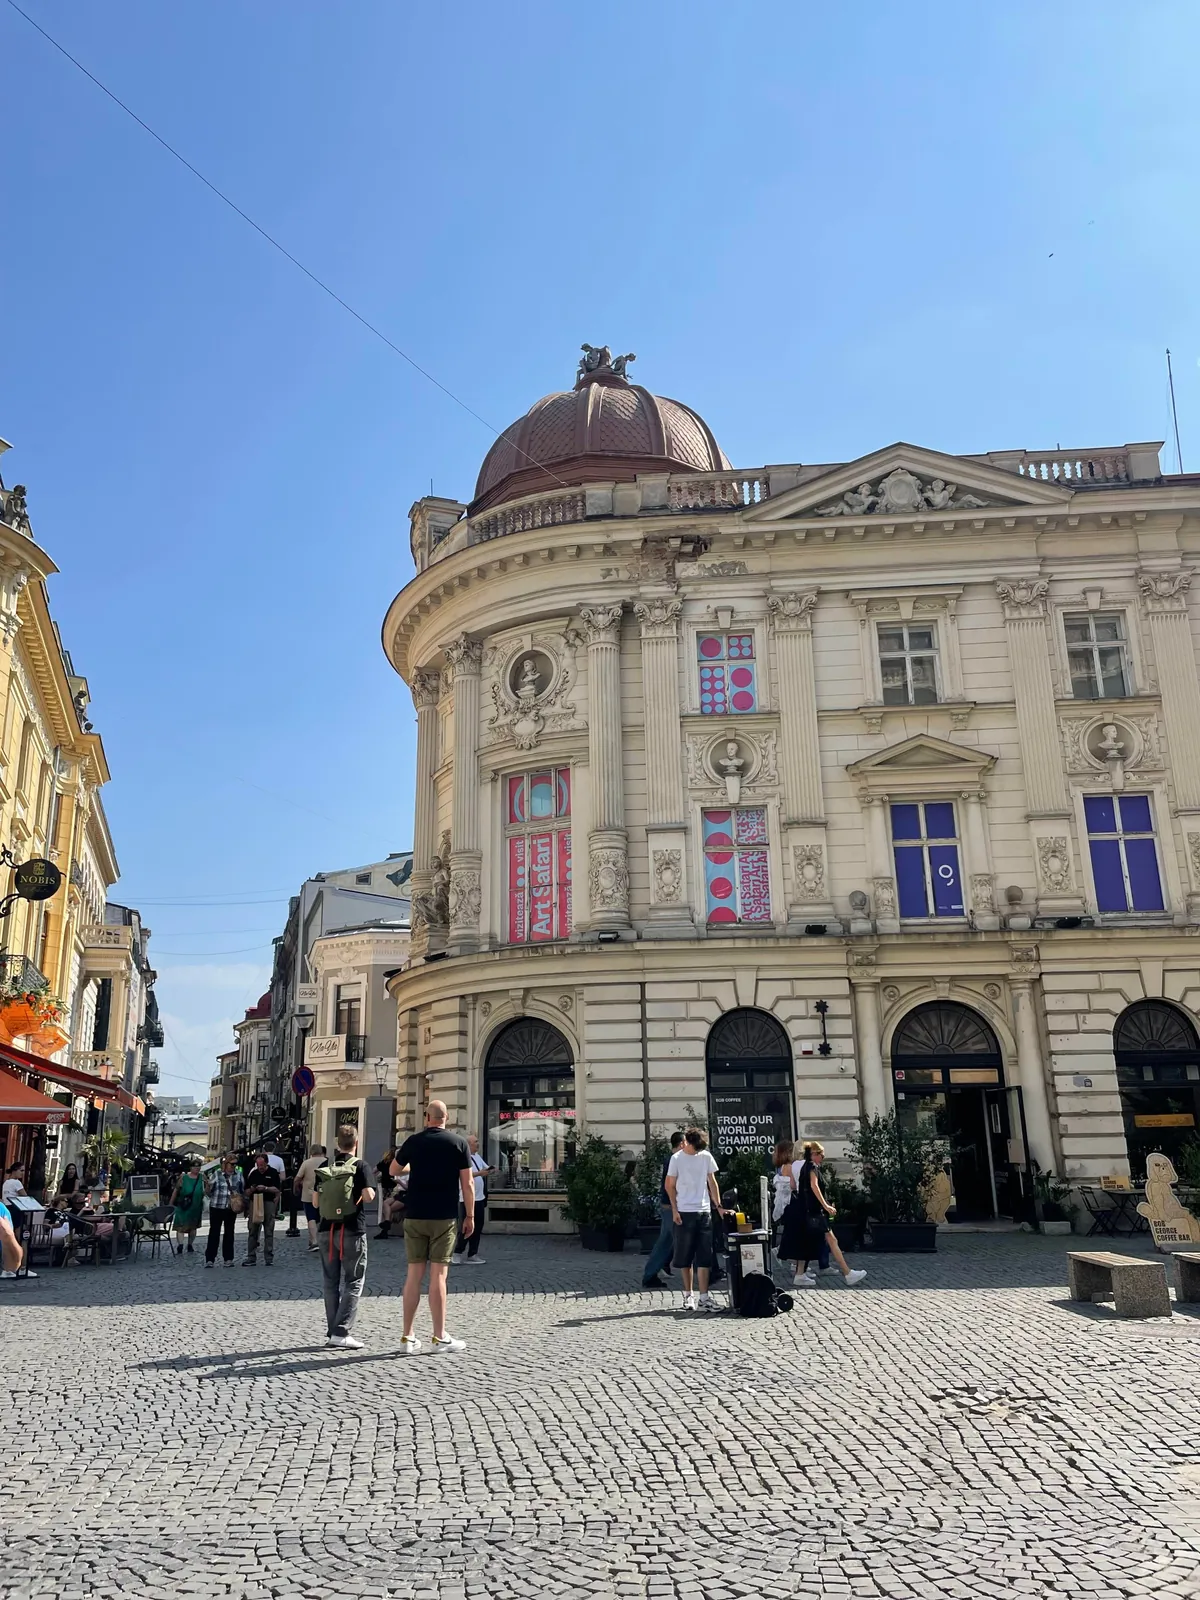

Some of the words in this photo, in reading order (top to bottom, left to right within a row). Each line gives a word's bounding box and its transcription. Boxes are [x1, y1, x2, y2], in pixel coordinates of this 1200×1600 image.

[563, 833, 572, 855] visit
[514, 840, 524, 862] visit
[532, 838, 550, 897] Safari
[20, 875, 56, 885] NOBIS
[514, 892, 524, 939] vizitează
[533, 900, 550, 935] Art
[717, 1116, 748, 1125] FROM
[750, 1115, 773, 1124] OUR
[717, 1126, 757, 1135] WORLD
[718, 1135, 775, 1145] CHAMPION
[718, 1145, 733, 1155] TO
[1153, 1220, 1166, 1228] BOB
[1155, 1227, 1178, 1235] GEORGE
[1178, 1233, 1191, 1241] BAR
